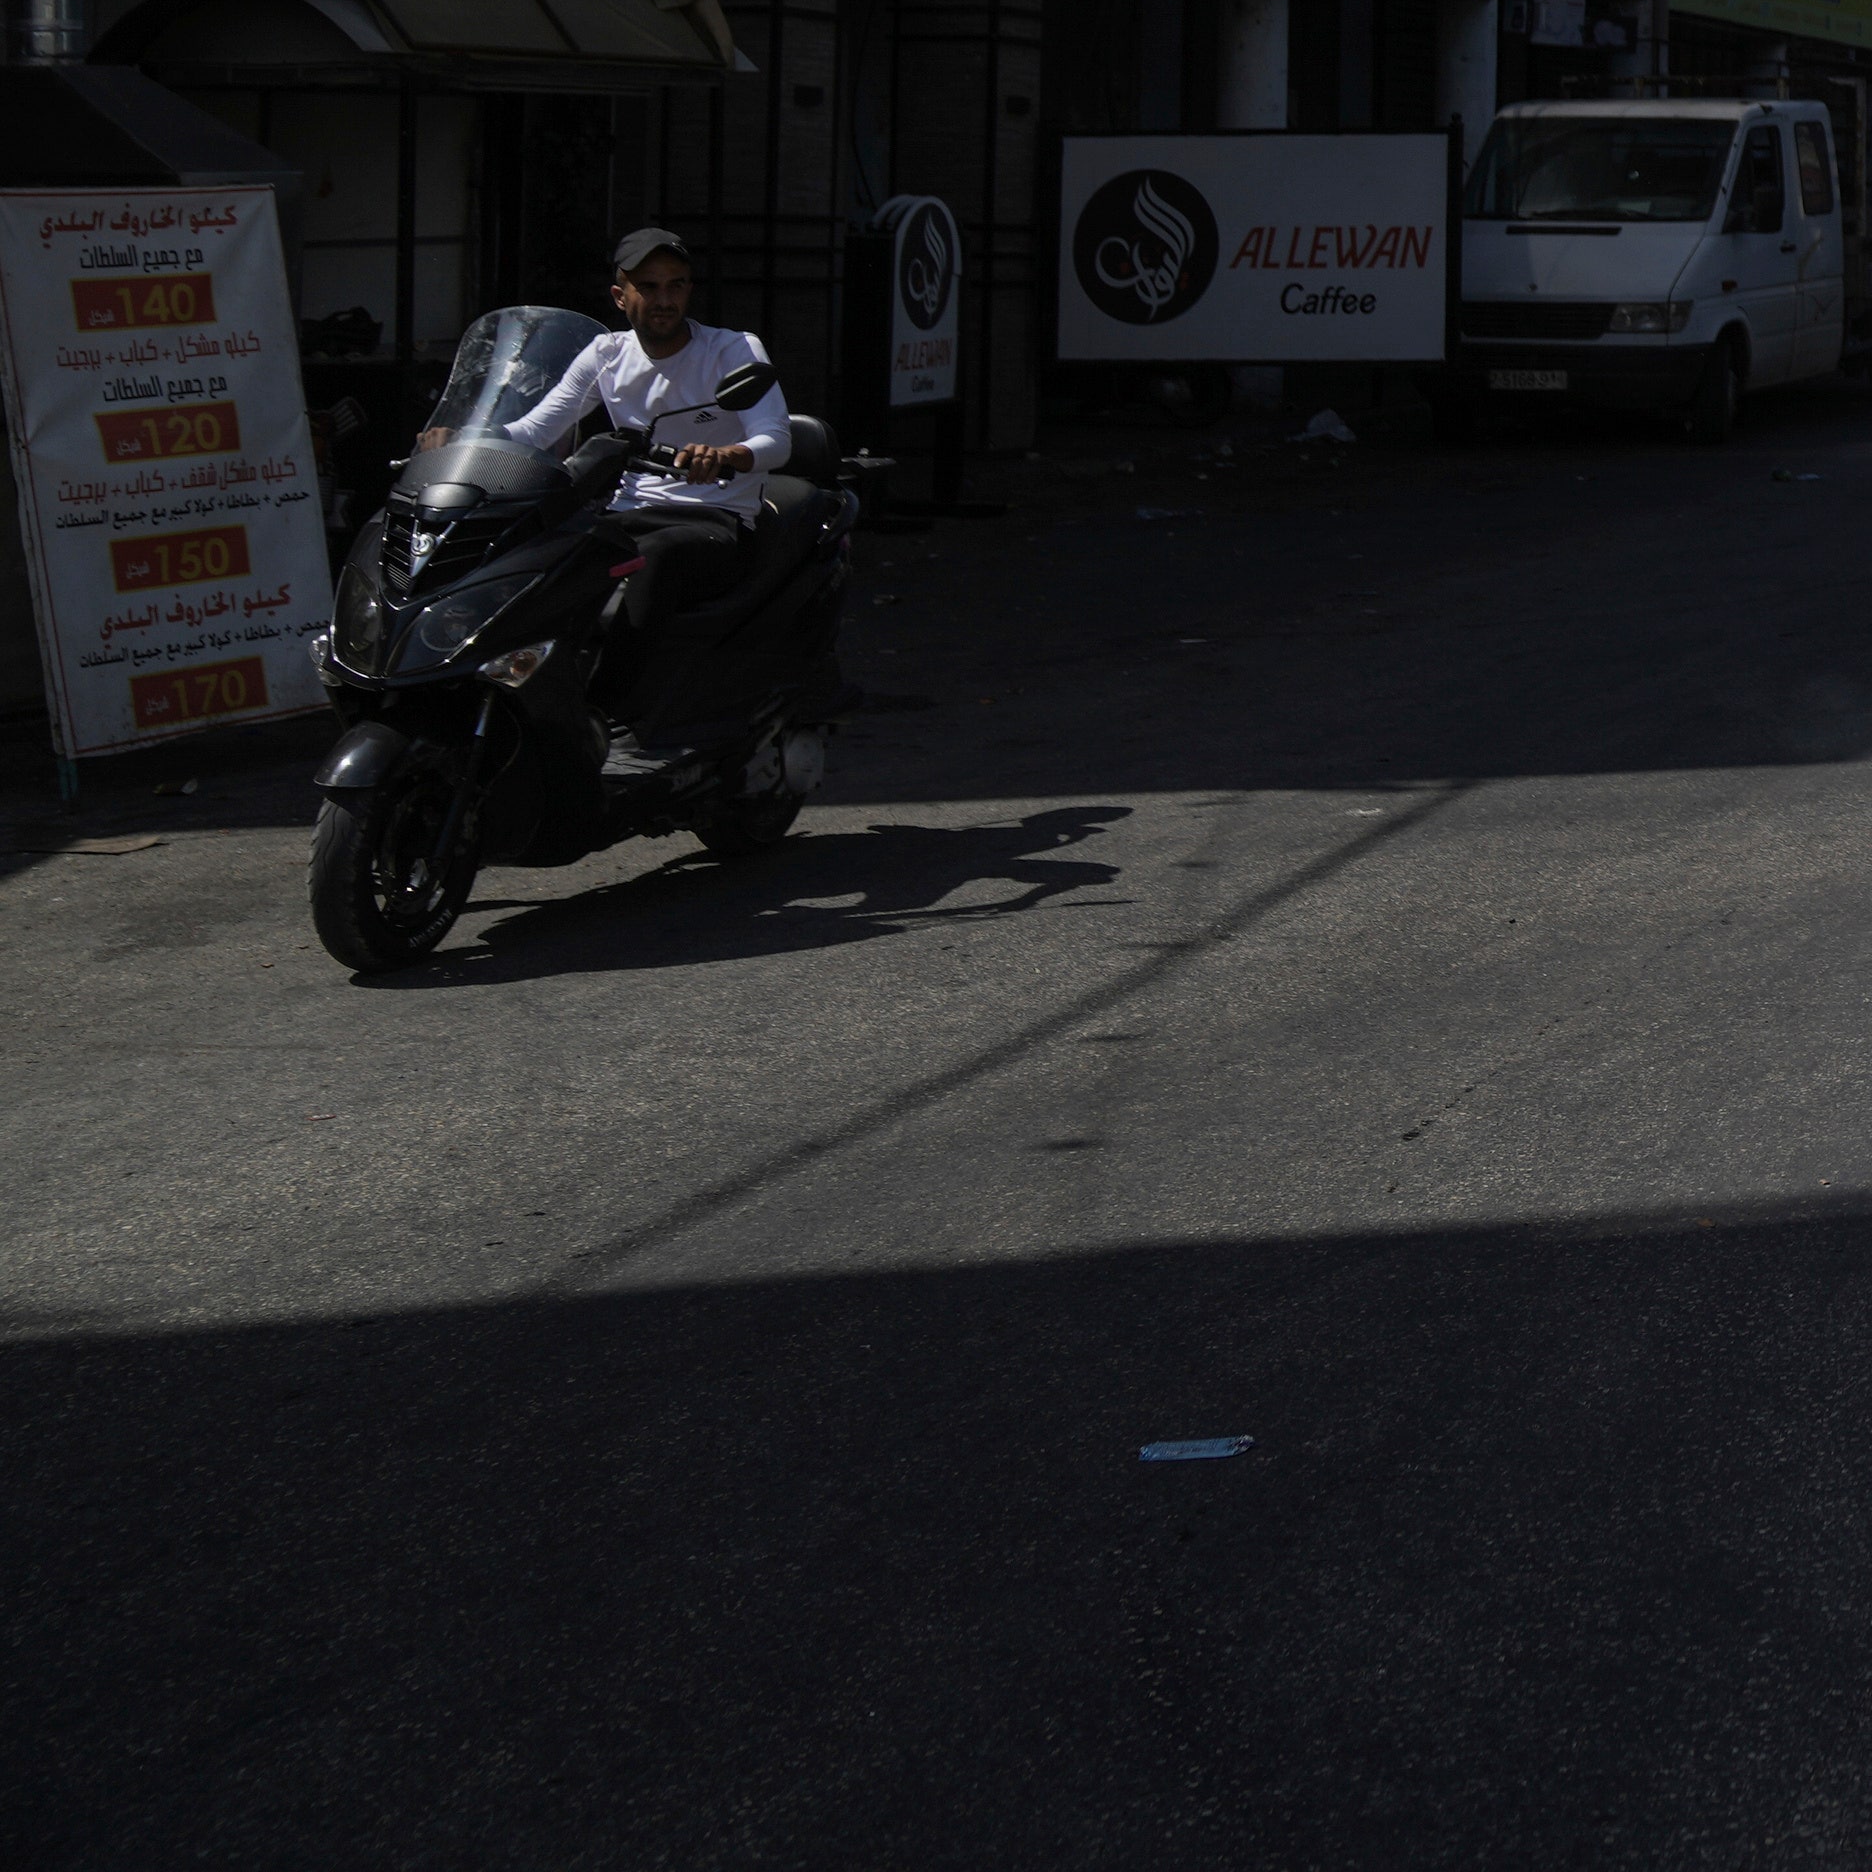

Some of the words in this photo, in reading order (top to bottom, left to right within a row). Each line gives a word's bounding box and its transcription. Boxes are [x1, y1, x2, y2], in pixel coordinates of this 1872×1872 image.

[38, 209, 105, 249] البلدي
[109, 202, 183, 237] الخاروف
[189, 203, 239, 234] كيلو
[79, 244, 140, 270] السلطات
[185, 247, 204, 271] مع
[1229, 223, 1434, 270] ALLEWAN
[143, 249, 181, 273] جميع
[115, 282, 196, 325] 140
[1279, 282, 1378, 315] Caffee
[56, 346, 102, 371] برجيت
[119, 338, 158, 366] كباب
[175, 332, 221, 365] مشكل
[224, 330, 262, 360] كيلو
[894, 337, 954, 373] ALLEWAN
[102, 375, 163, 403] السلطات
[166, 377, 204, 403] جميع
[209, 375, 228, 394] مع
[141, 411, 223, 456] 120
[125, 469, 164, 498] كباب
[181, 461, 218, 490] شقف
[219, 457, 257, 491] مشكل
[261, 454, 297, 485] كيلو
[57, 480, 108, 506] برجيت
[193, 495, 216, 518] كولا
[226, 492, 262, 511] بطاطا
[275, 491, 311, 509] حمص
[55, 509, 109, 529] السلطات
[112, 510, 148, 530] جميع
[152, 507, 167, 526] مع
[153, 537, 230, 584] 150
[165, 590, 237, 628] الخاروف
[242, 582, 292, 619] كيلو
[99, 603, 160, 651] البلدي
[208, 629, 231, 651] كولا
[243, 624, 283, 642] بطاطا
[79, 646, 129, 668] السلطات
[132, 647, 163, 668] جميع
[166, 643, 181, 662] مع
[170, 668, 248, 719] 170
